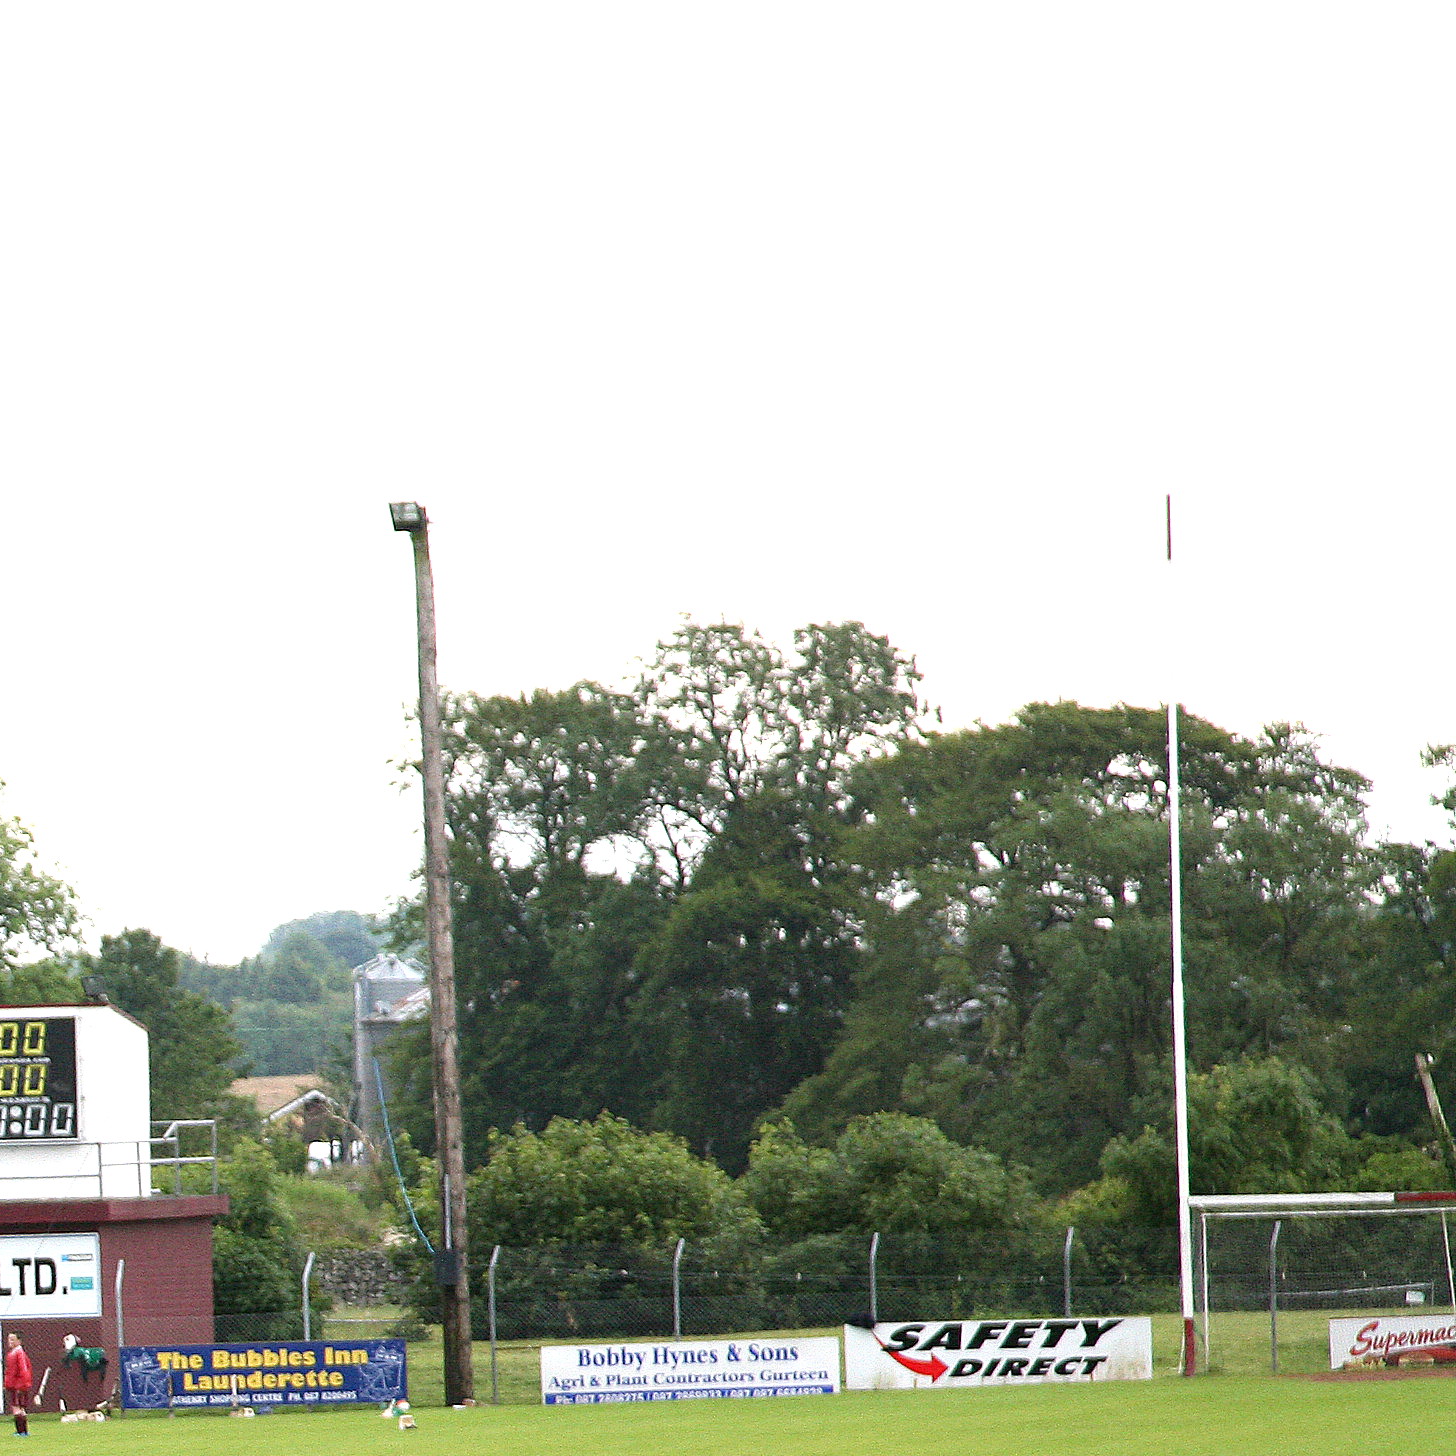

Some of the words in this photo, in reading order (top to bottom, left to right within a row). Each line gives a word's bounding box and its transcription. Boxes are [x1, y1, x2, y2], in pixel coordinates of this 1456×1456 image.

[886, 1318, 1125, 1352] SAFETY
[156, 1351, 203, 1370] The
[212, 1347, 316, 1369] Bubbles
[325, 1346, 370, 1365] Inn
[577, 1346, 647, 1371] Bobby
[652, 1344, 718, 1369] Hynes
[727, 1343, 742, 1362] &
[748, 1342, 800, 1362] Sons
[947, 1356, 1108, 1379] DIRECT
[183, 1370, 346, 1391] Launderette
[590, 1376, 600, 1386] &
[606, 1374, 649, 1386] Plant
[654, 1370, 755, 1385] Contractors
[760, 1369, 829, 1382] Gurteen
